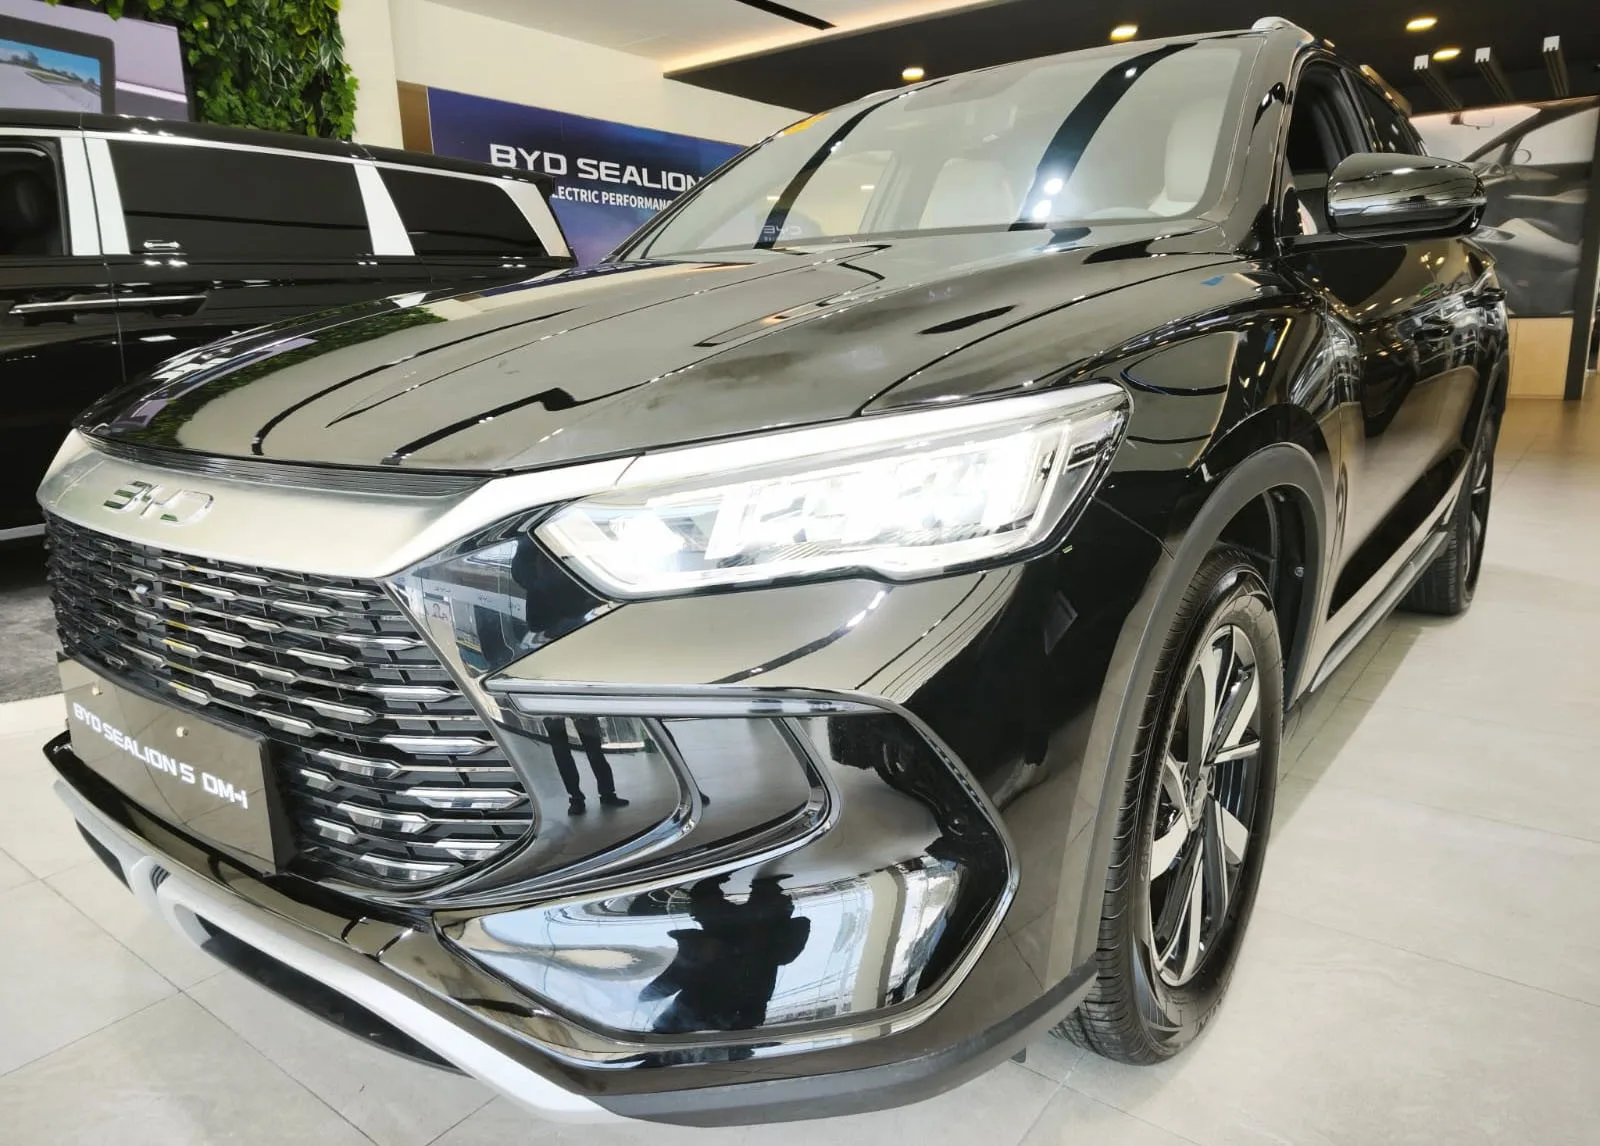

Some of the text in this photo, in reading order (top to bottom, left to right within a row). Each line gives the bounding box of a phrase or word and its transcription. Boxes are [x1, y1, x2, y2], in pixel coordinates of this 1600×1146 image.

[490, 143, 704, 192] BYD SEALION
[103, 480, 214, 526] BYD
[73, 702, 102, 733] BYD
[102, 722, 177, 776] SEALION
[179, 762, 196, 784] 5
